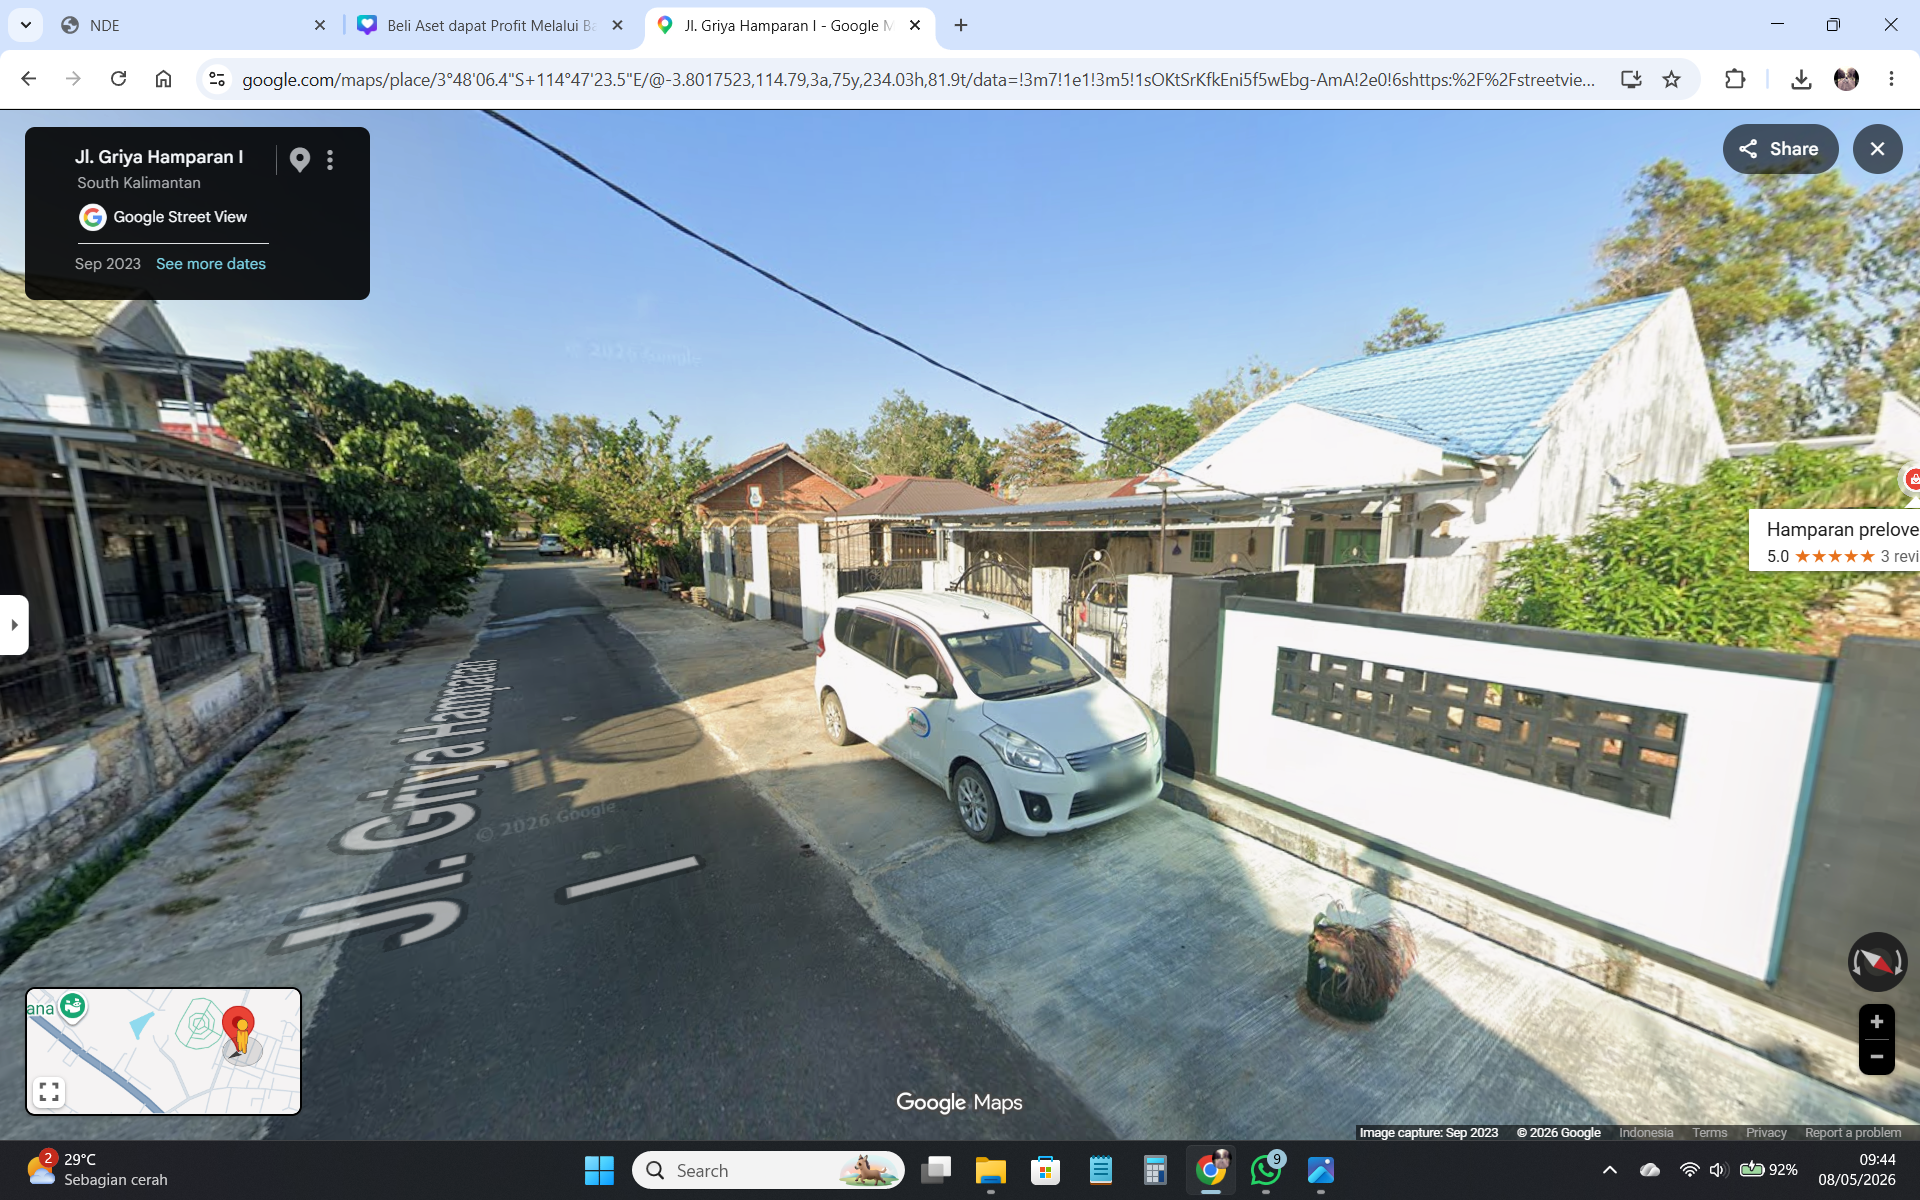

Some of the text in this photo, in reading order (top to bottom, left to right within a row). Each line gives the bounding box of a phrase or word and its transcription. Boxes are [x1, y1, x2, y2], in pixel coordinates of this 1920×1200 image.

[91, 20, 119, 31] NDE
[389, 20, 410, 31] Beli
[415, 20, 444, 31] Aset
[449, 20, 486, 34] dapat
[492, 20, 527, 31] Profit
[532, 20, 578, 31] Melalui
[685, 20, 697, 31] Jl.
[702, 20, 734, 34] Griya
[741, 20, 808, 34] Hamparan
[831, 20, 878, 34] Google
[45, 1153, 52, 1163] 2
[65, 1154, 95, 1165] 29°C
[1273, 1153, 1281, 1164] 9
[1860, 1154, 1896, 1165] 09:44
[678, 1164, 728, 1177] Search
[1769, 1164, 1798, 1175] 92%
[65, 1173, 167, 1188] Sebagian cerah
[1819, 1174, 1896, 1186] 08/05/2026
